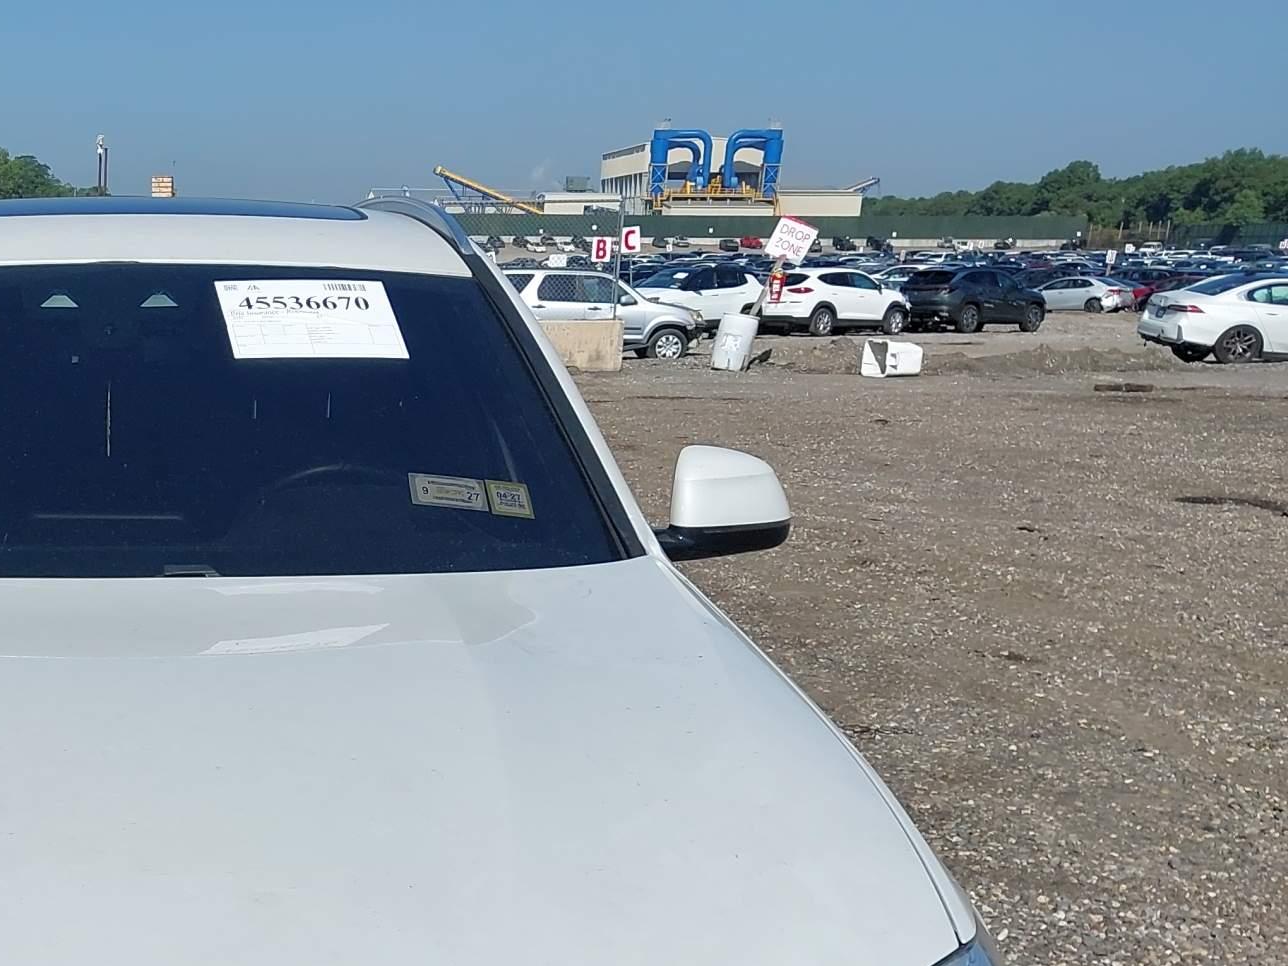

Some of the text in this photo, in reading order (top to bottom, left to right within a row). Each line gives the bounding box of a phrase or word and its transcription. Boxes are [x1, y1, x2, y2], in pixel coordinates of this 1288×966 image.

[624, 229, 636, 251] C
[779, 223, 811, 242] DROP
[595, 239, 607, 260] B
[774, 237, 804, 257] ZONE
[238, 295, 370, 311] 45536670
[466, 491, 480, 502] 27
